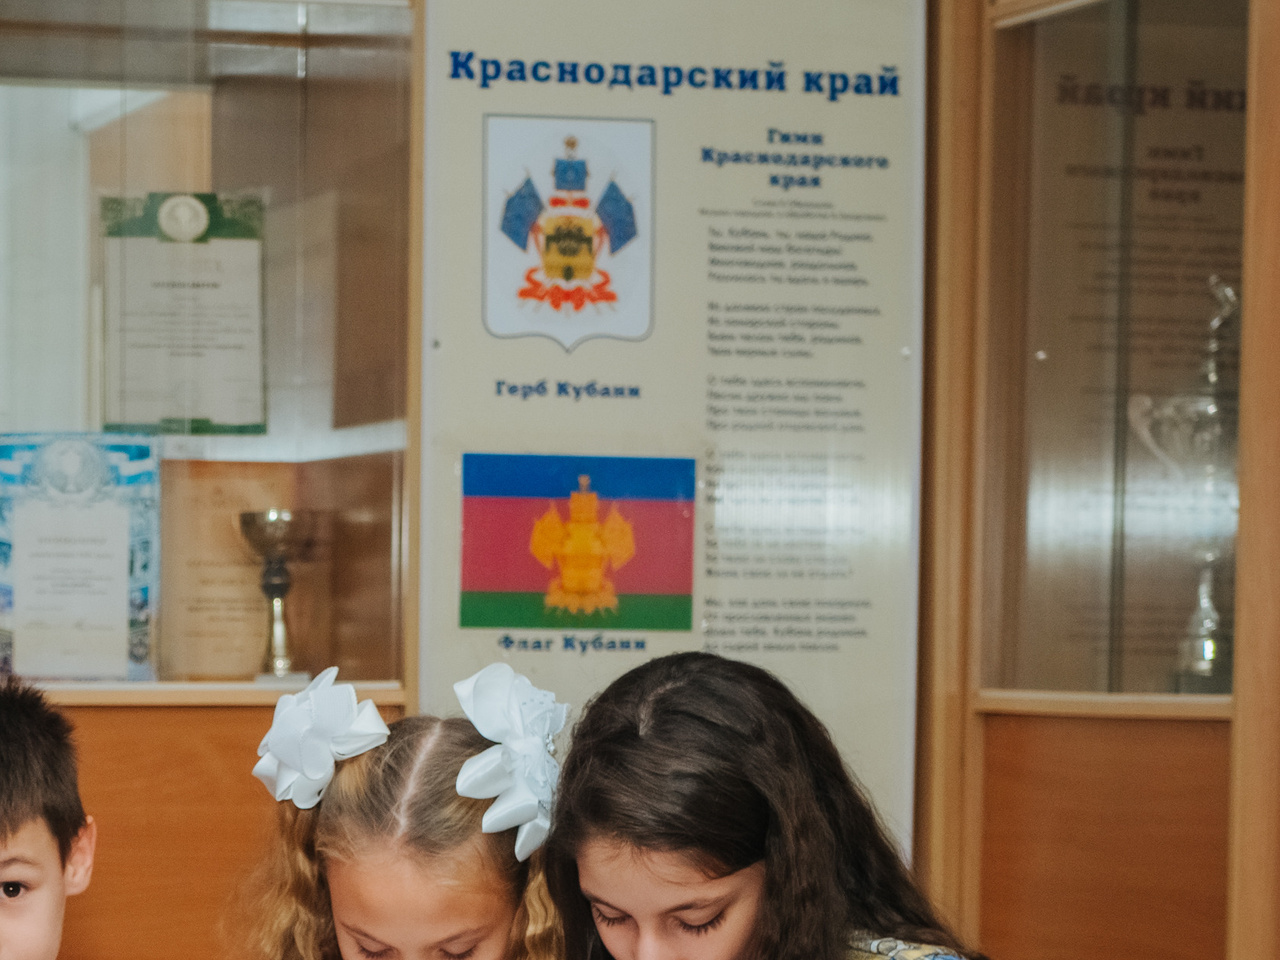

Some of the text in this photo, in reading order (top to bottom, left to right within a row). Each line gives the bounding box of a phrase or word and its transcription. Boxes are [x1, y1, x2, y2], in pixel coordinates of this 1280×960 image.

[449, 50, 900, 102] Краснодарский край
[701, 148, 889, 171] Краснодарского
[496, 380, 641, 401] Герб Кубани
[499, 632, 646, 656] Флаг Кубани
